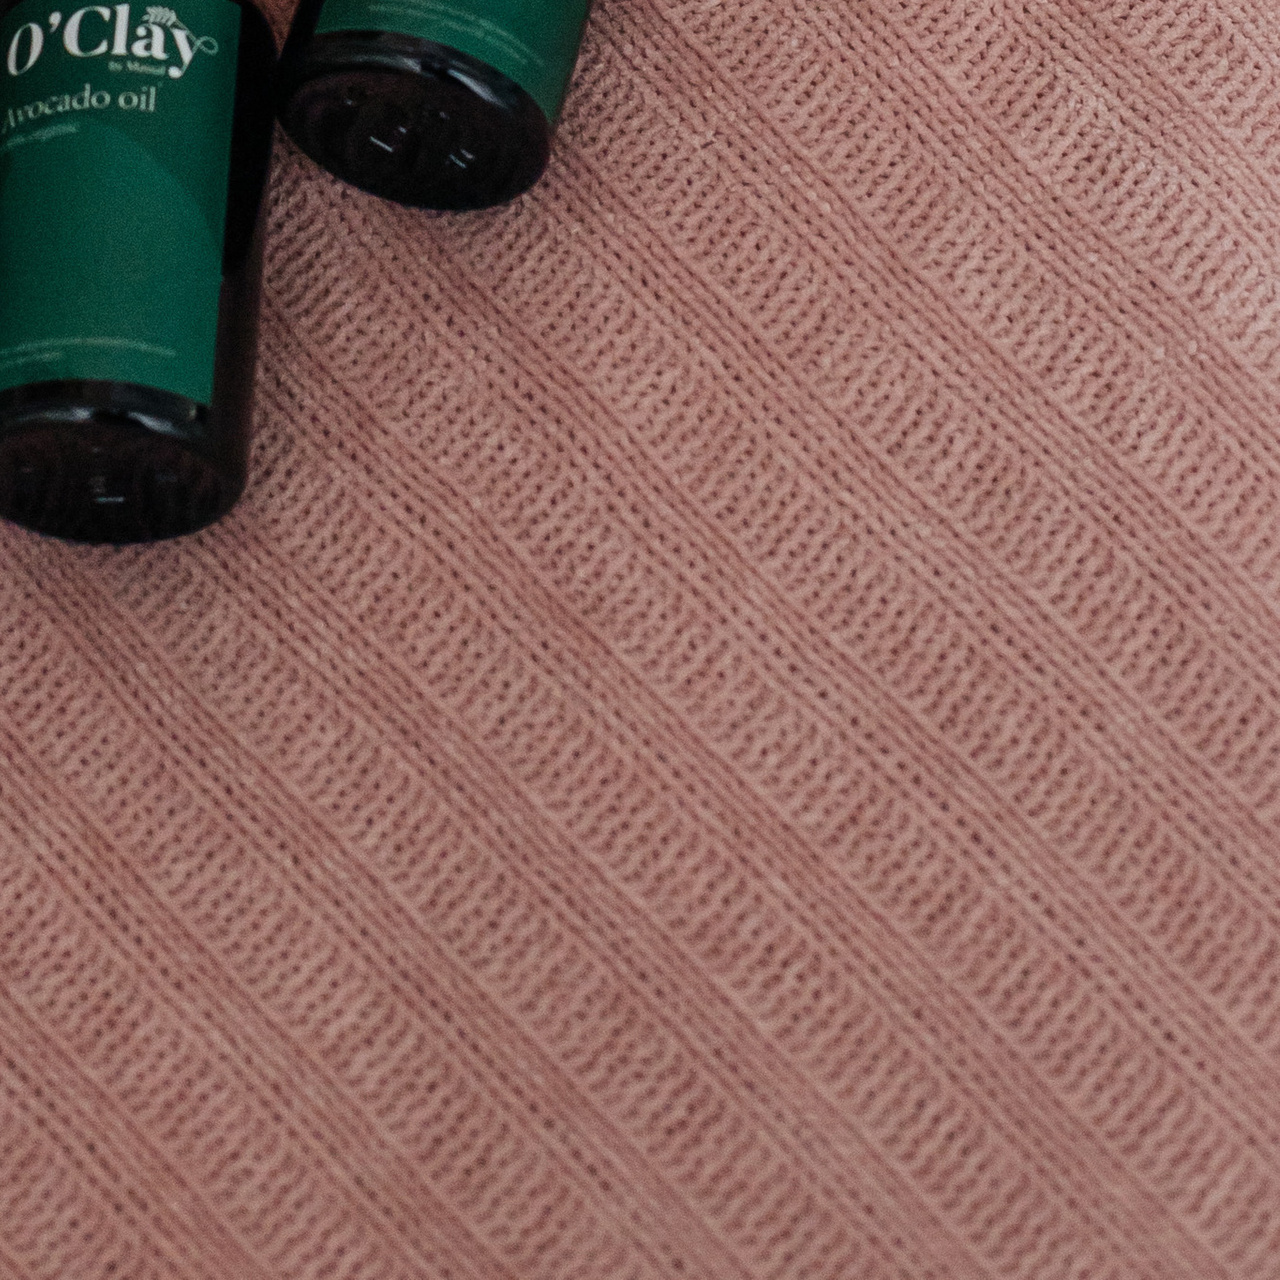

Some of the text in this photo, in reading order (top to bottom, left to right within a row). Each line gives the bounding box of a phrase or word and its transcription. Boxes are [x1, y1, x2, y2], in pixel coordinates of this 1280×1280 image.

[6, 2, 218, 79] O'Clay
[1, 82, 157, 135] Avocado oil
